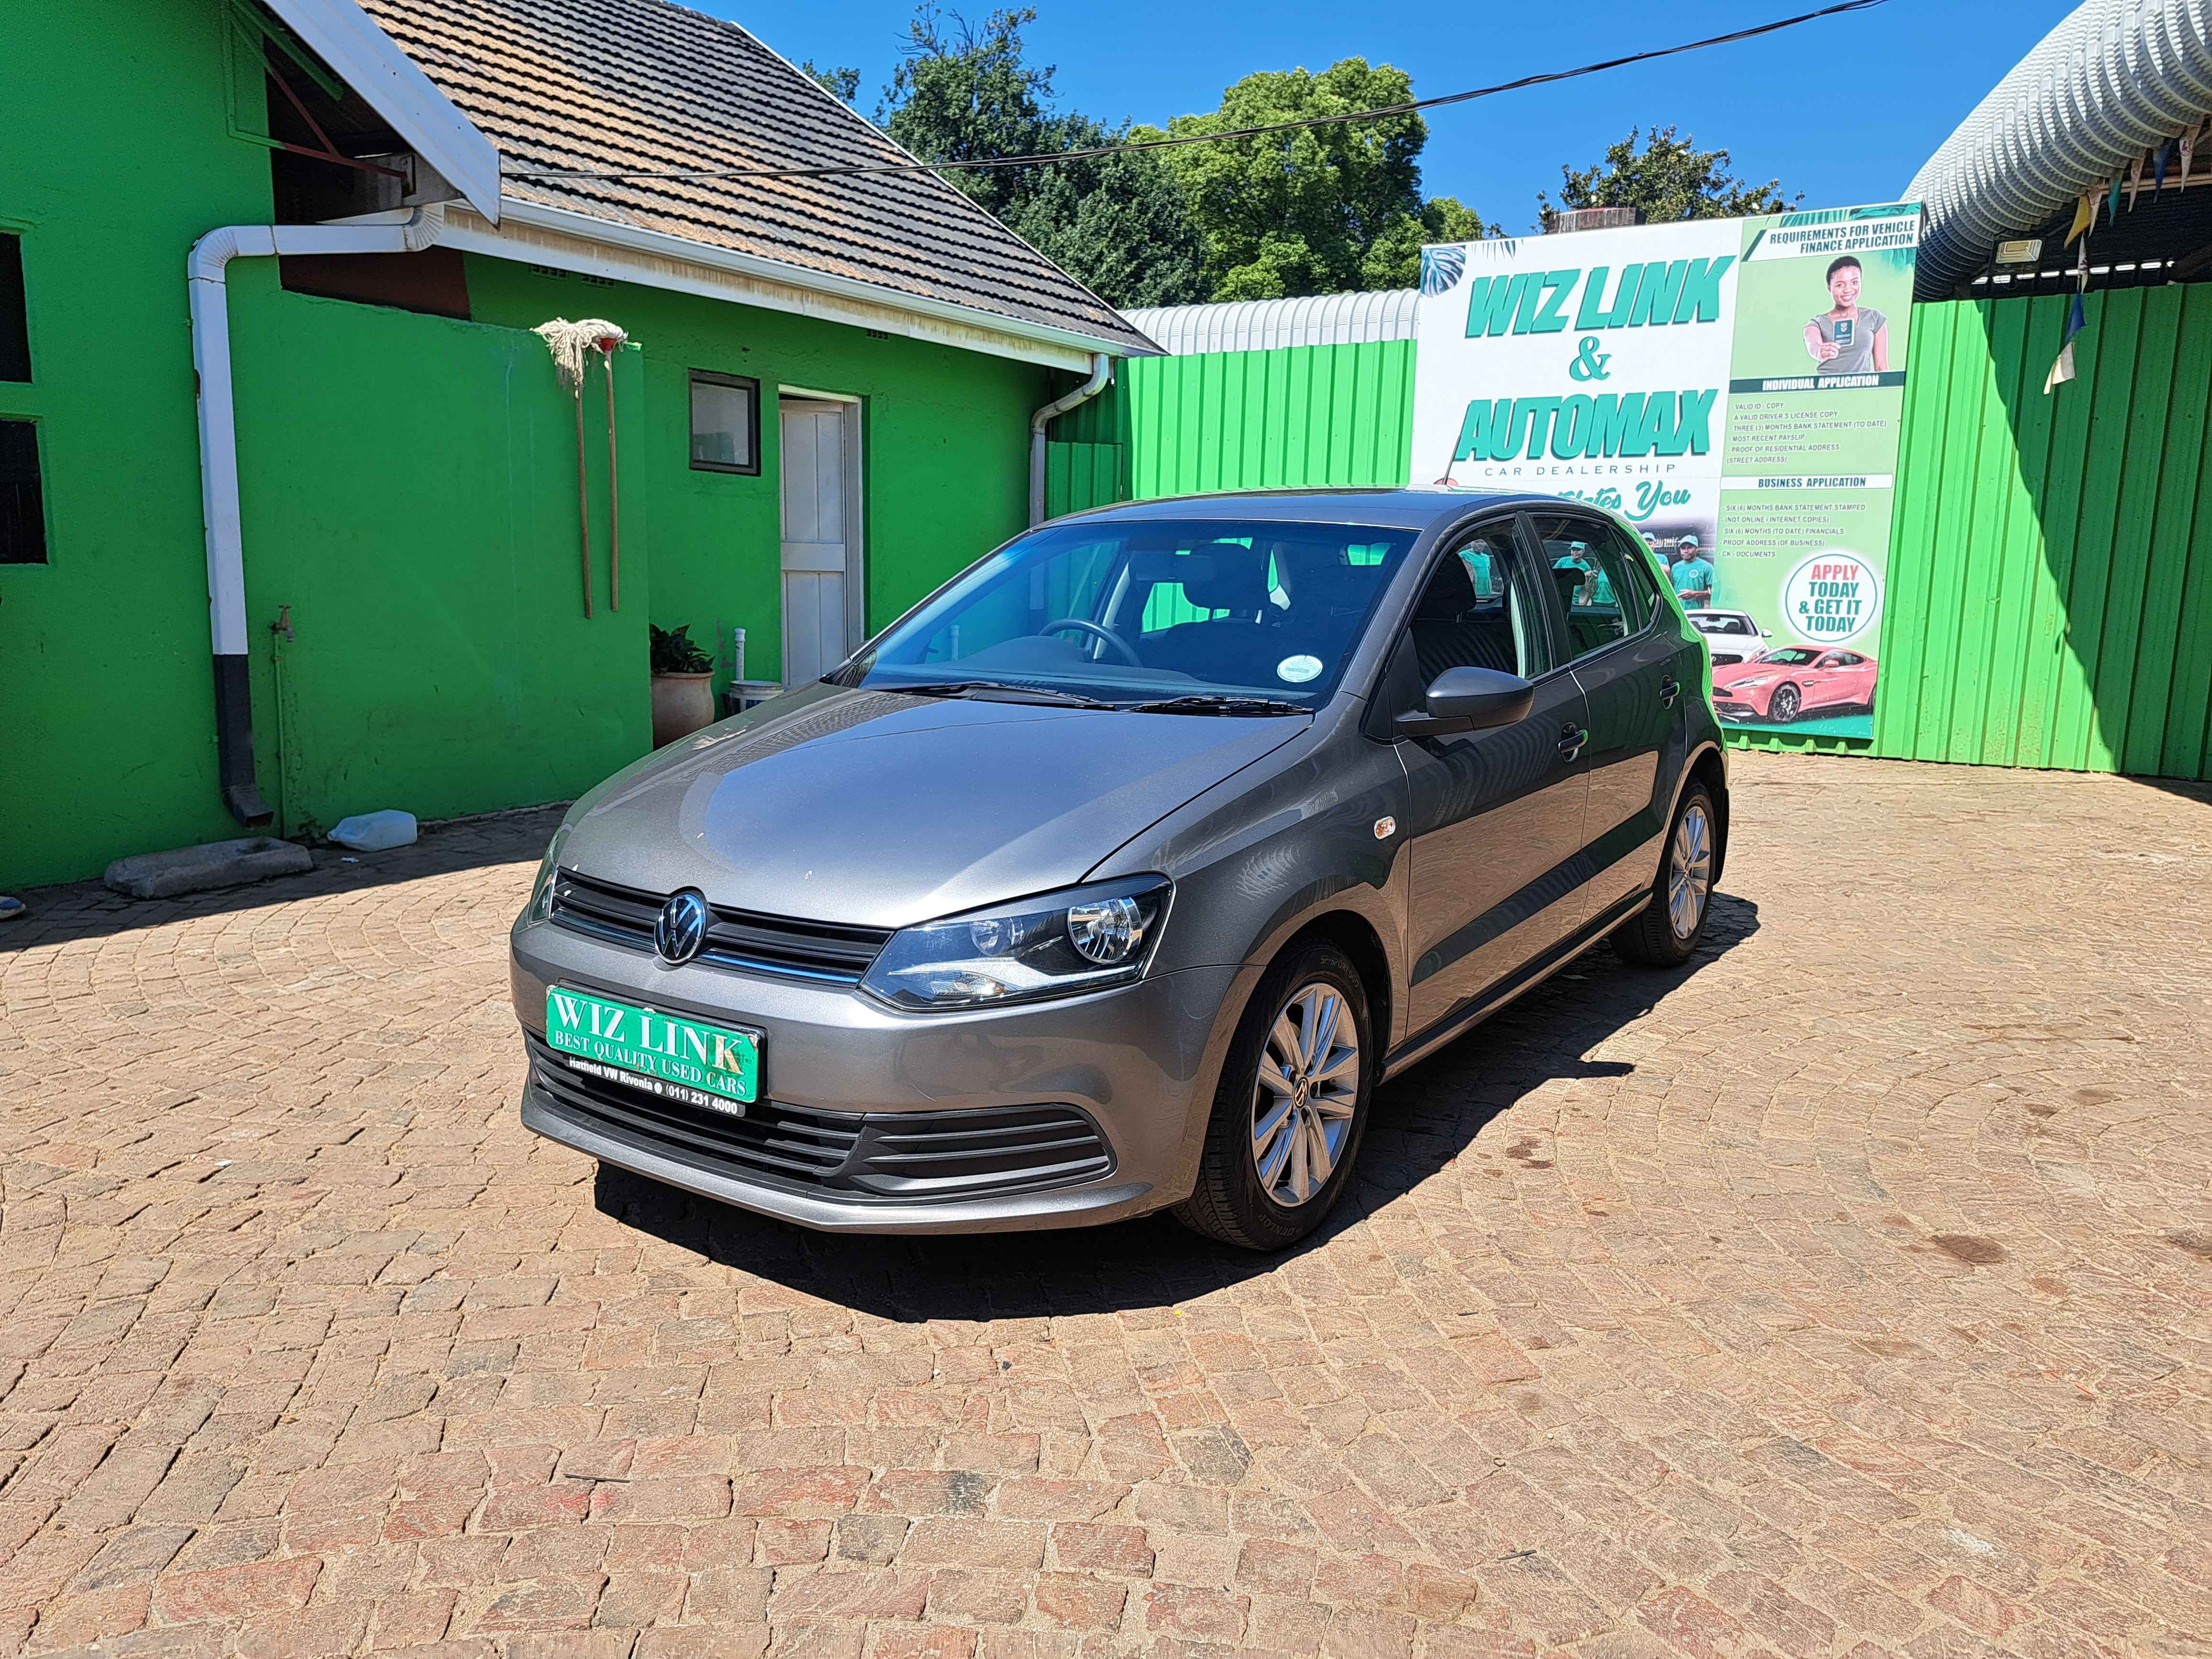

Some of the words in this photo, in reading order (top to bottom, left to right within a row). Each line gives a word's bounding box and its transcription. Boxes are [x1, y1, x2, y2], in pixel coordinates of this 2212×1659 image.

[1770, 227, 1847, 244] REQUIREMENTS
[1850, 225, 1869, 237] FOR
[1872, 220, 1915, 234] VEHICLE
[1800, 240, 1842, 254] FINANCE
[1845, 233, 1913, 250] APPLICATION
[1464, 268, 1582, 339] WIZ
[1574, 255, 1737, 332] LINK
[1569, 336, 1612, 382] &
[1762, 378, 1814, 391] INDIVIDUAL
[1818, 375, 1879, 388] APPLICATION
[1453, 388, 1719, 463] AUTOMAX
[1485, 467, 1522, 476] CAR
[1537, 464, 1675, 475] DEALERSHIP
[1758, 478, 1802, 488] BUSINESS
[1806, 477, 1866, 487] APPLICATION
[1624, 480, 1691, 521] You
[1811, 564, 1859, 580] APPLY
[1809, 581, 1859, 598] TODAY
[1799, 601, 1810, 614] &
[1814, 599, 1843, 615] GET
[1847, 599, 1862, 615] IT
[1806, 616, 1856, 632] TODAY
[552, 993, 625, 1042] WIZ
[639, 1015, 744, 1075] LINK
[555, 1030, 590, 1052] BEST
[594, 1041, 657, 1070] QUALITY
[662, 1059, 701, 1083] USED
[706, 1072, 746, 1095] CARS
[603, 1066, 618, 1080] VW
[620, 1071, 653, 1091] Rivonia
[666, 1084, 688, 1101] (011)
[691, 1092, 708, 1106] 231
[712, 1098, 737, 1114] 4000
